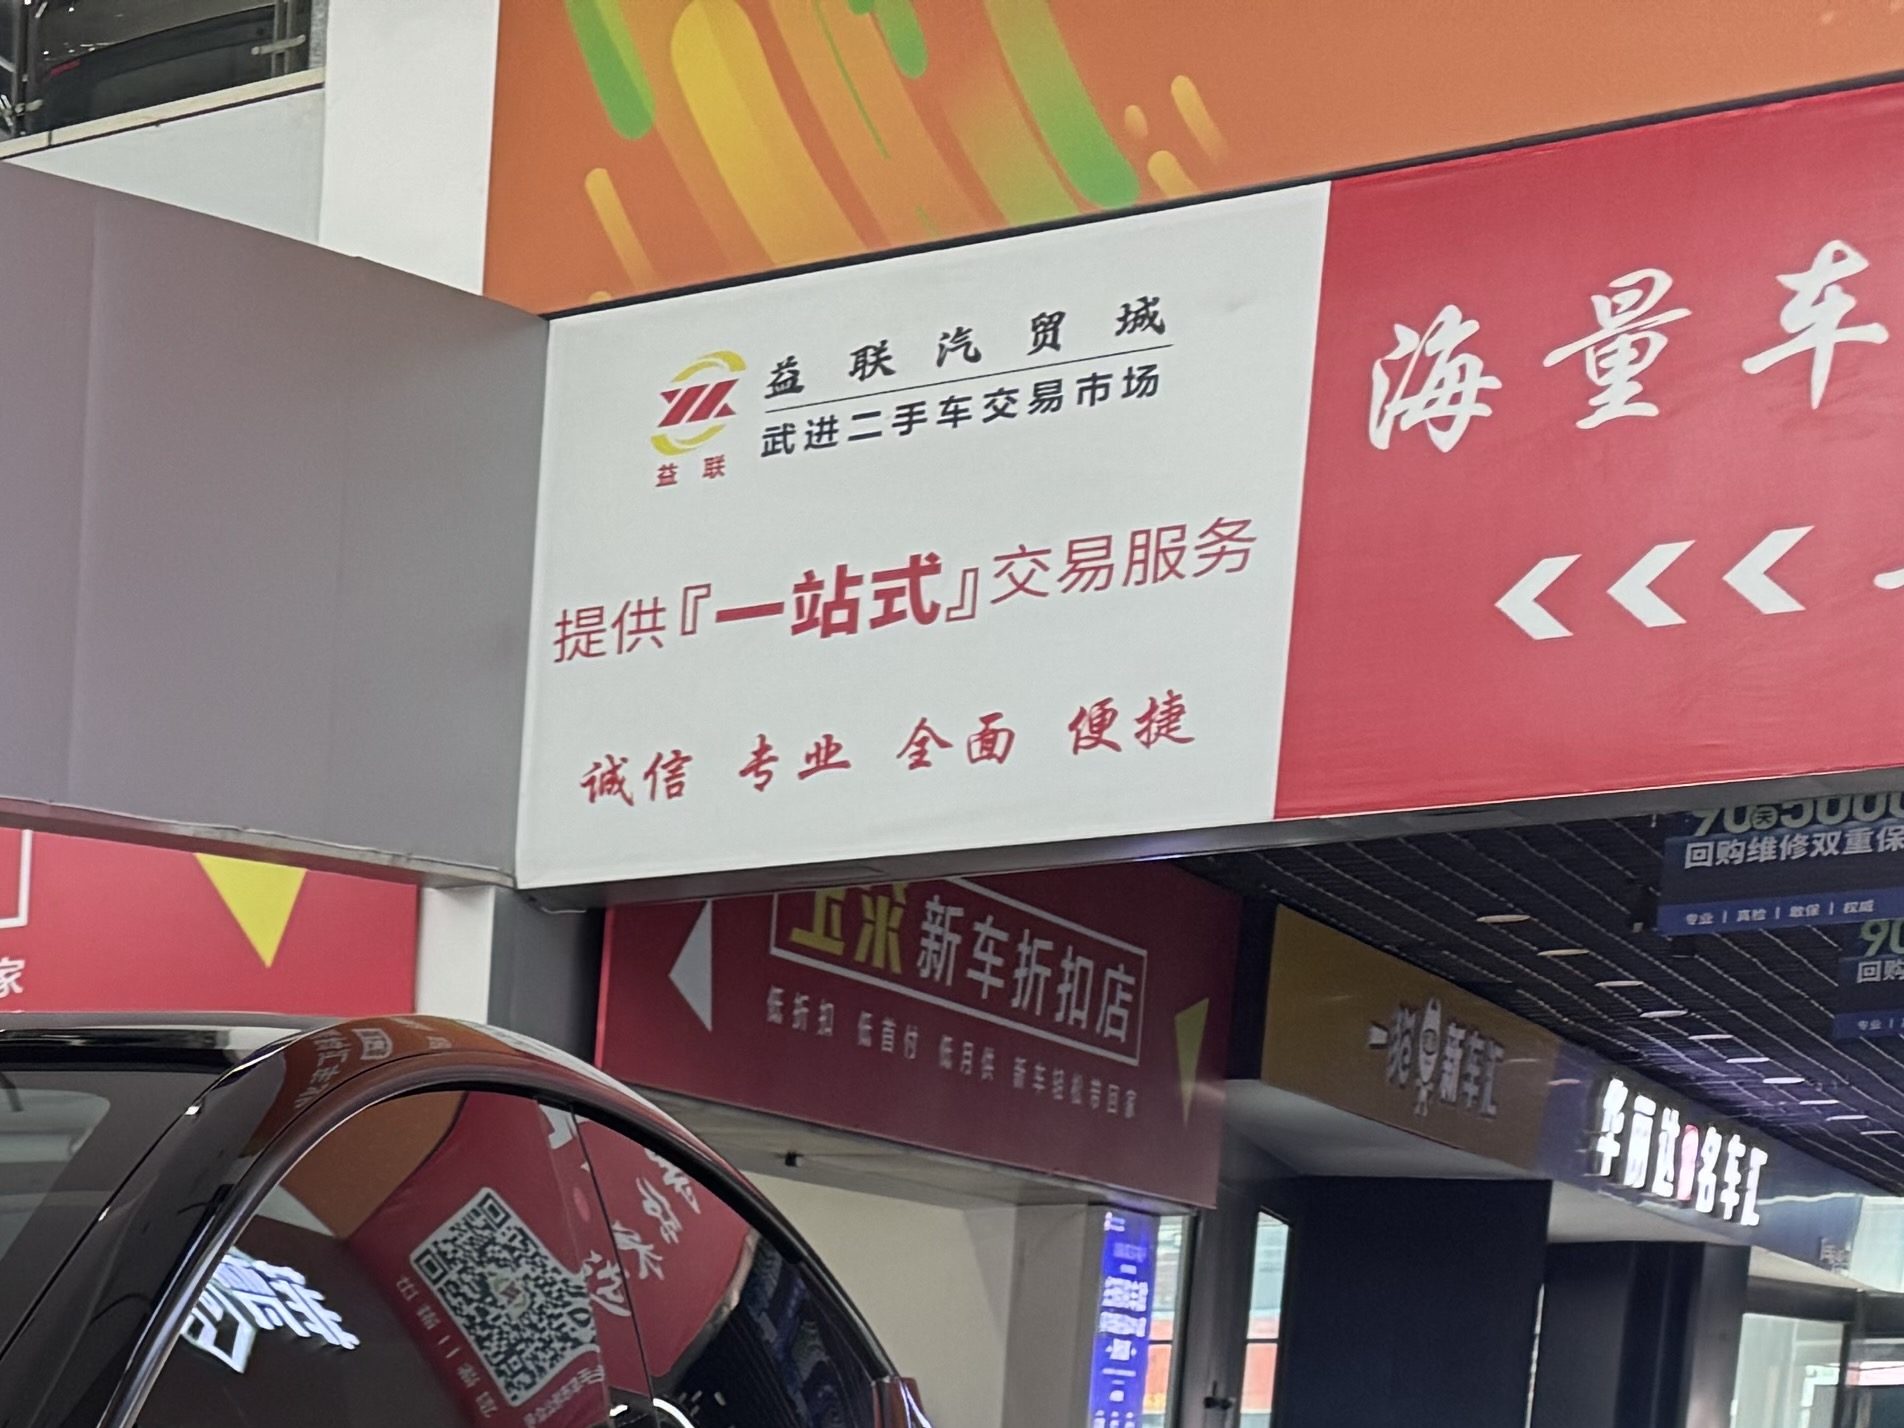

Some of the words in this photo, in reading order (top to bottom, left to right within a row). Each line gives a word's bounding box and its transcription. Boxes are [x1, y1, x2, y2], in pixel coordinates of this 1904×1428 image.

[763, 296, 1167, 399] 益联汽贸城
[1368, 239, 1889, 452] 海量车
[760, 363, 1161, 458] 武进二手车交易市场
[655, 454, 726, 488] 益联
[552, 516, 1258, 663] 提供『一站式』交易服务
[580, 748, 694, 808] 诚信
[738, 734, 852, 793] 专业
[895, 713, 1015, 772] 全面
[1068, 689, 1196, 755] 便捷
[917, 895, 1136, 1043] 新车折扣店
